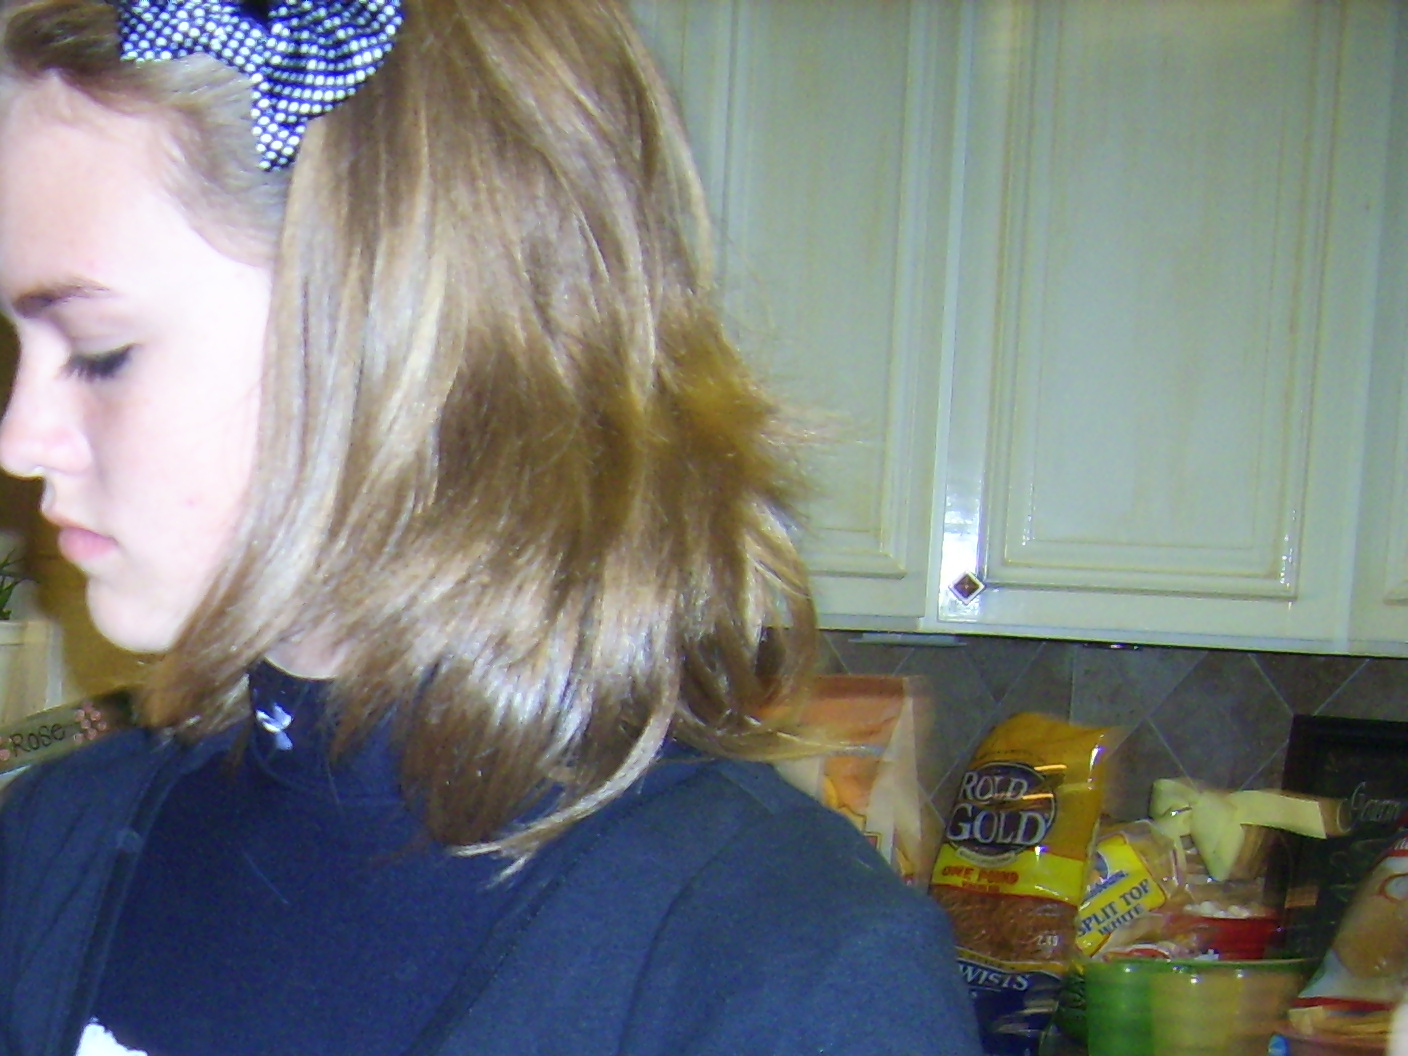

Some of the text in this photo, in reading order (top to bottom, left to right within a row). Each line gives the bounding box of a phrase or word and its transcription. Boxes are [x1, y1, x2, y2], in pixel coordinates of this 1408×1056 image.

[958, 771, 1028, 801] ROLD
[947, 803, 1048, 846] GOLD
[1119, 879, 1150, 906] TOP
[958, 963, 1030, 991] WISTS
